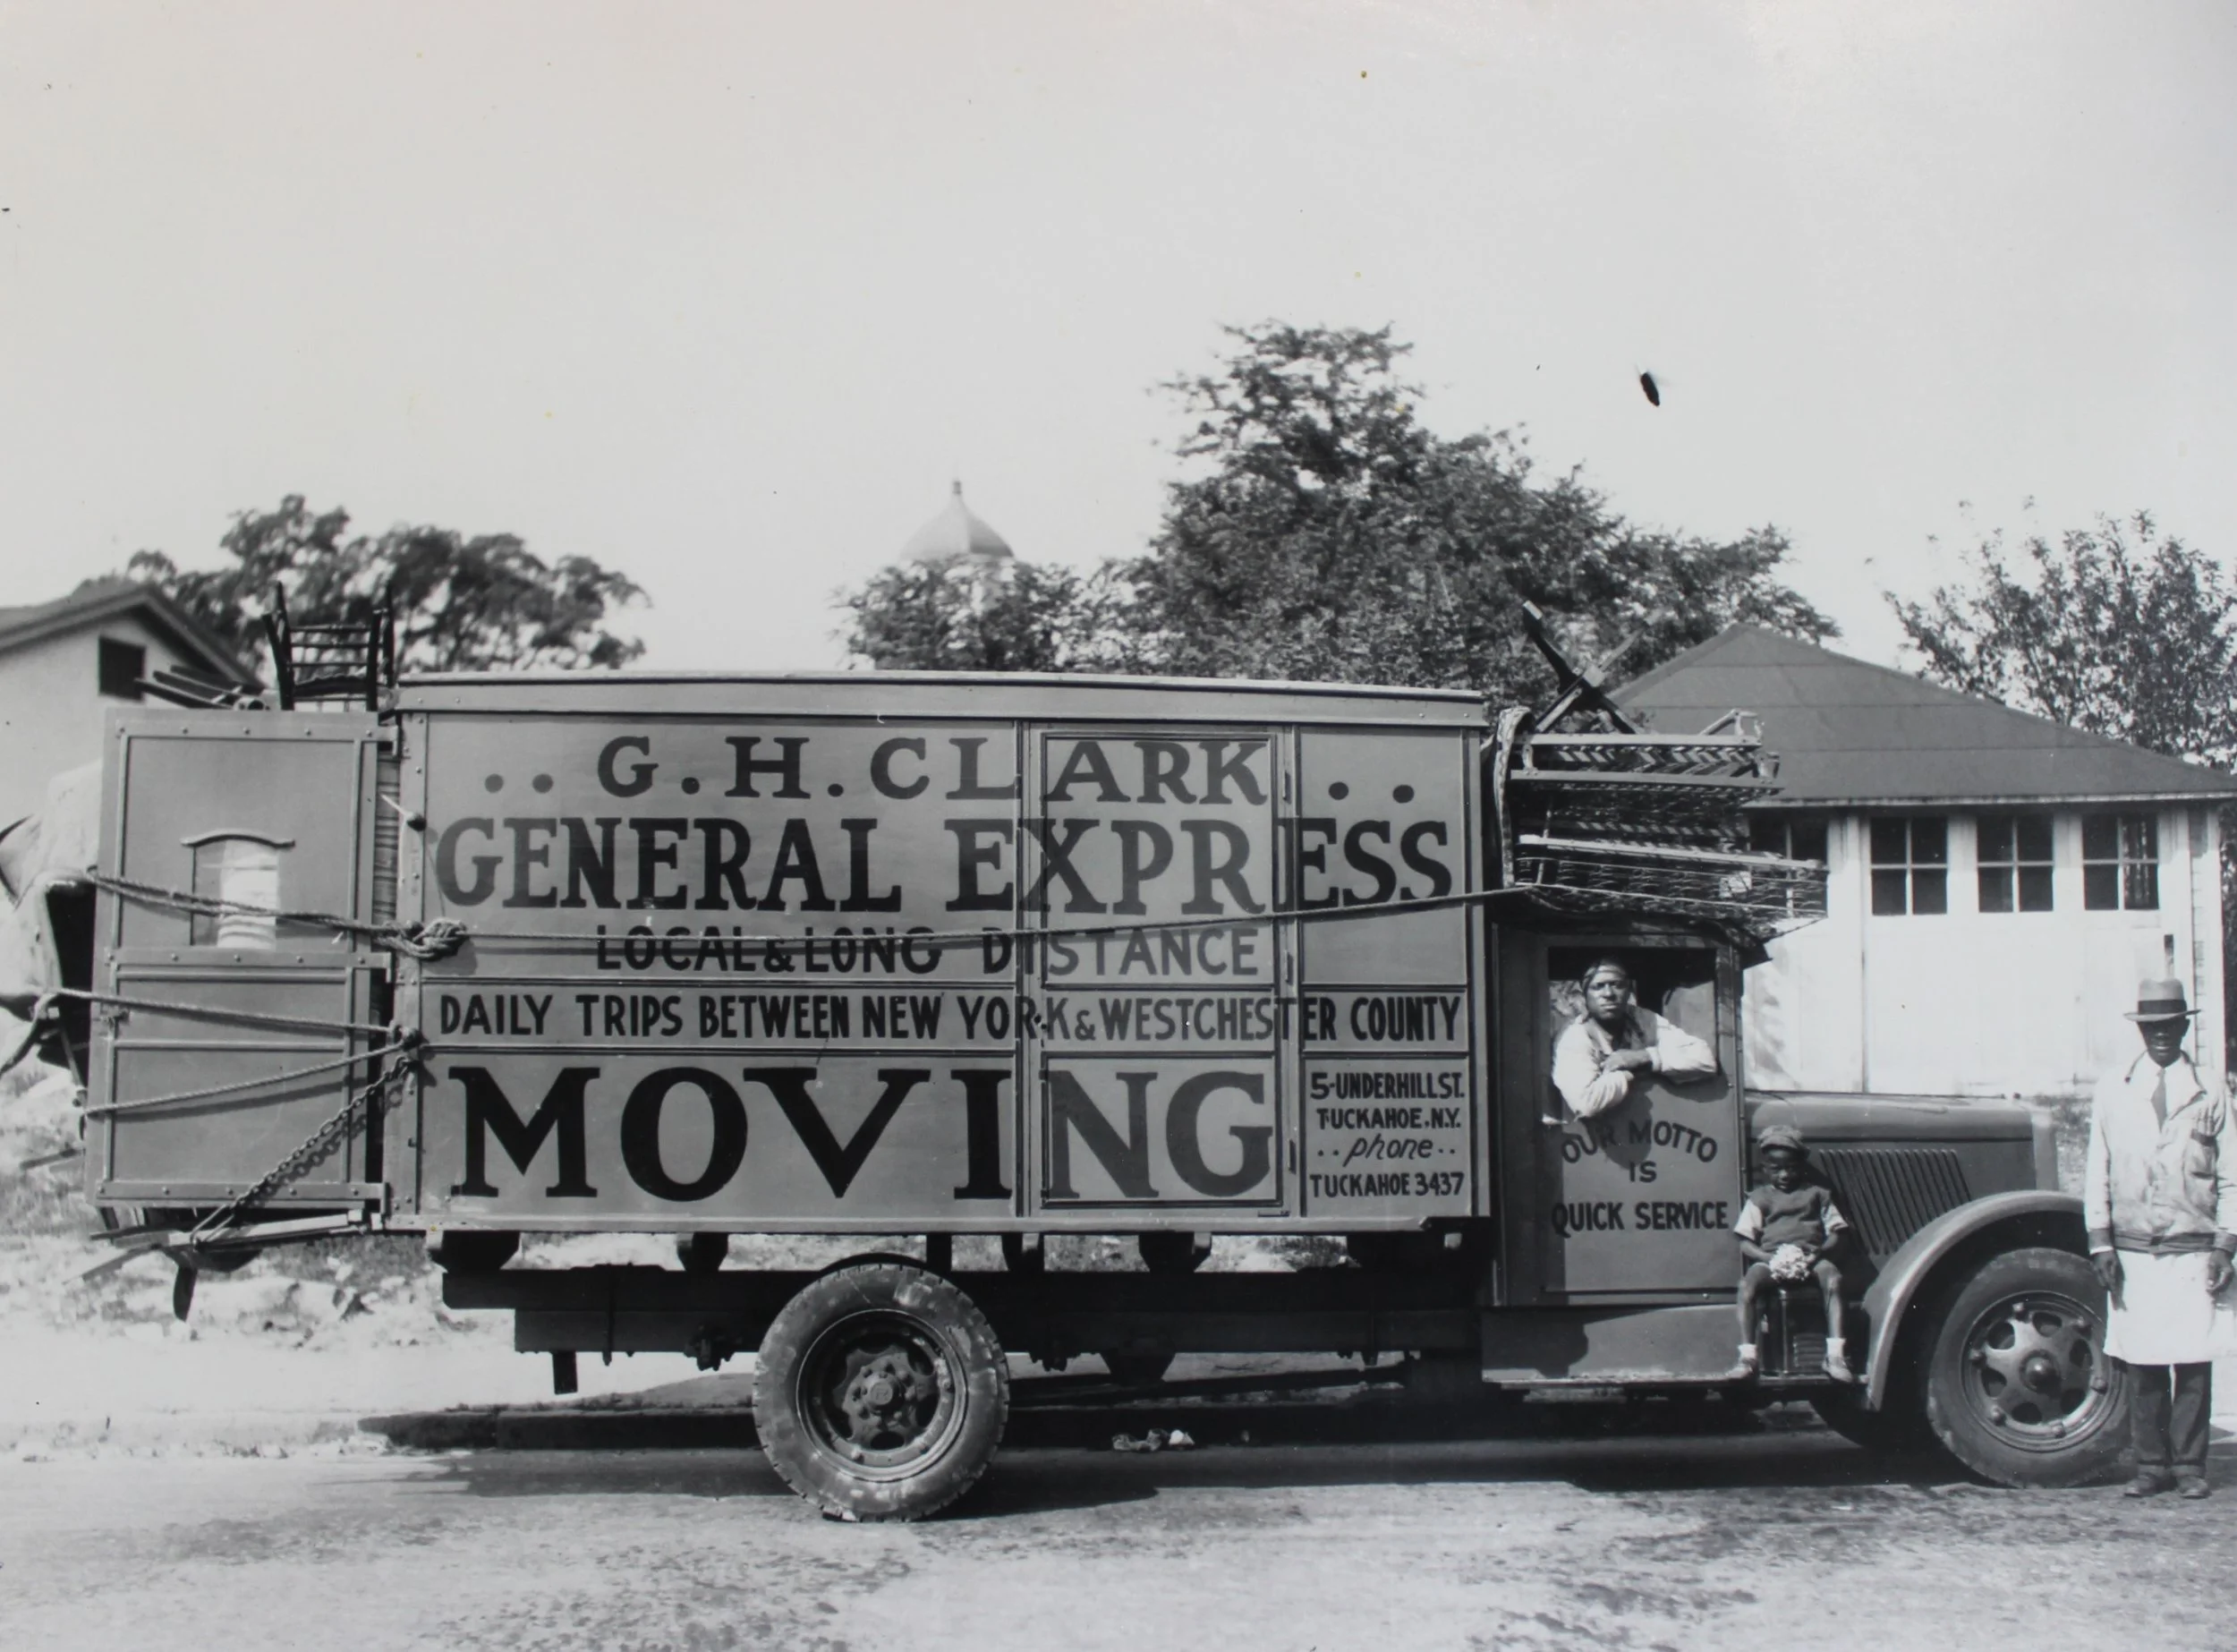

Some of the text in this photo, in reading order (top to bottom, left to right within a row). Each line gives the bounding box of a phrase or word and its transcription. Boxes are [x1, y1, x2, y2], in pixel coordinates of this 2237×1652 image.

[870, 737, 1268, 805] CLARK
[436, 817, 1453, 914] GENERAL EXPRESS
[982, 926, 1259, 976] DISTANCE
[440, 994, 553, 1036] DAILY
[575, 994, 683, 1037] TRIPS
[700, 994, 850, 1039] BETWEEN
[863, 995, 942, 1040] NEW
[1350, 996, 1461, 1042] COUNTY
[447, 1067, 1274, 1202] MOVING
[1561, 1120, 1718, 1163] OUR MOTTO
[1310, 1171, 1465, 1197] TUCKAHOE 3437
[1629, 1161, 1657, 1183] IS
[1552, 1202, 1729, 1239] QUICK SERVICE
